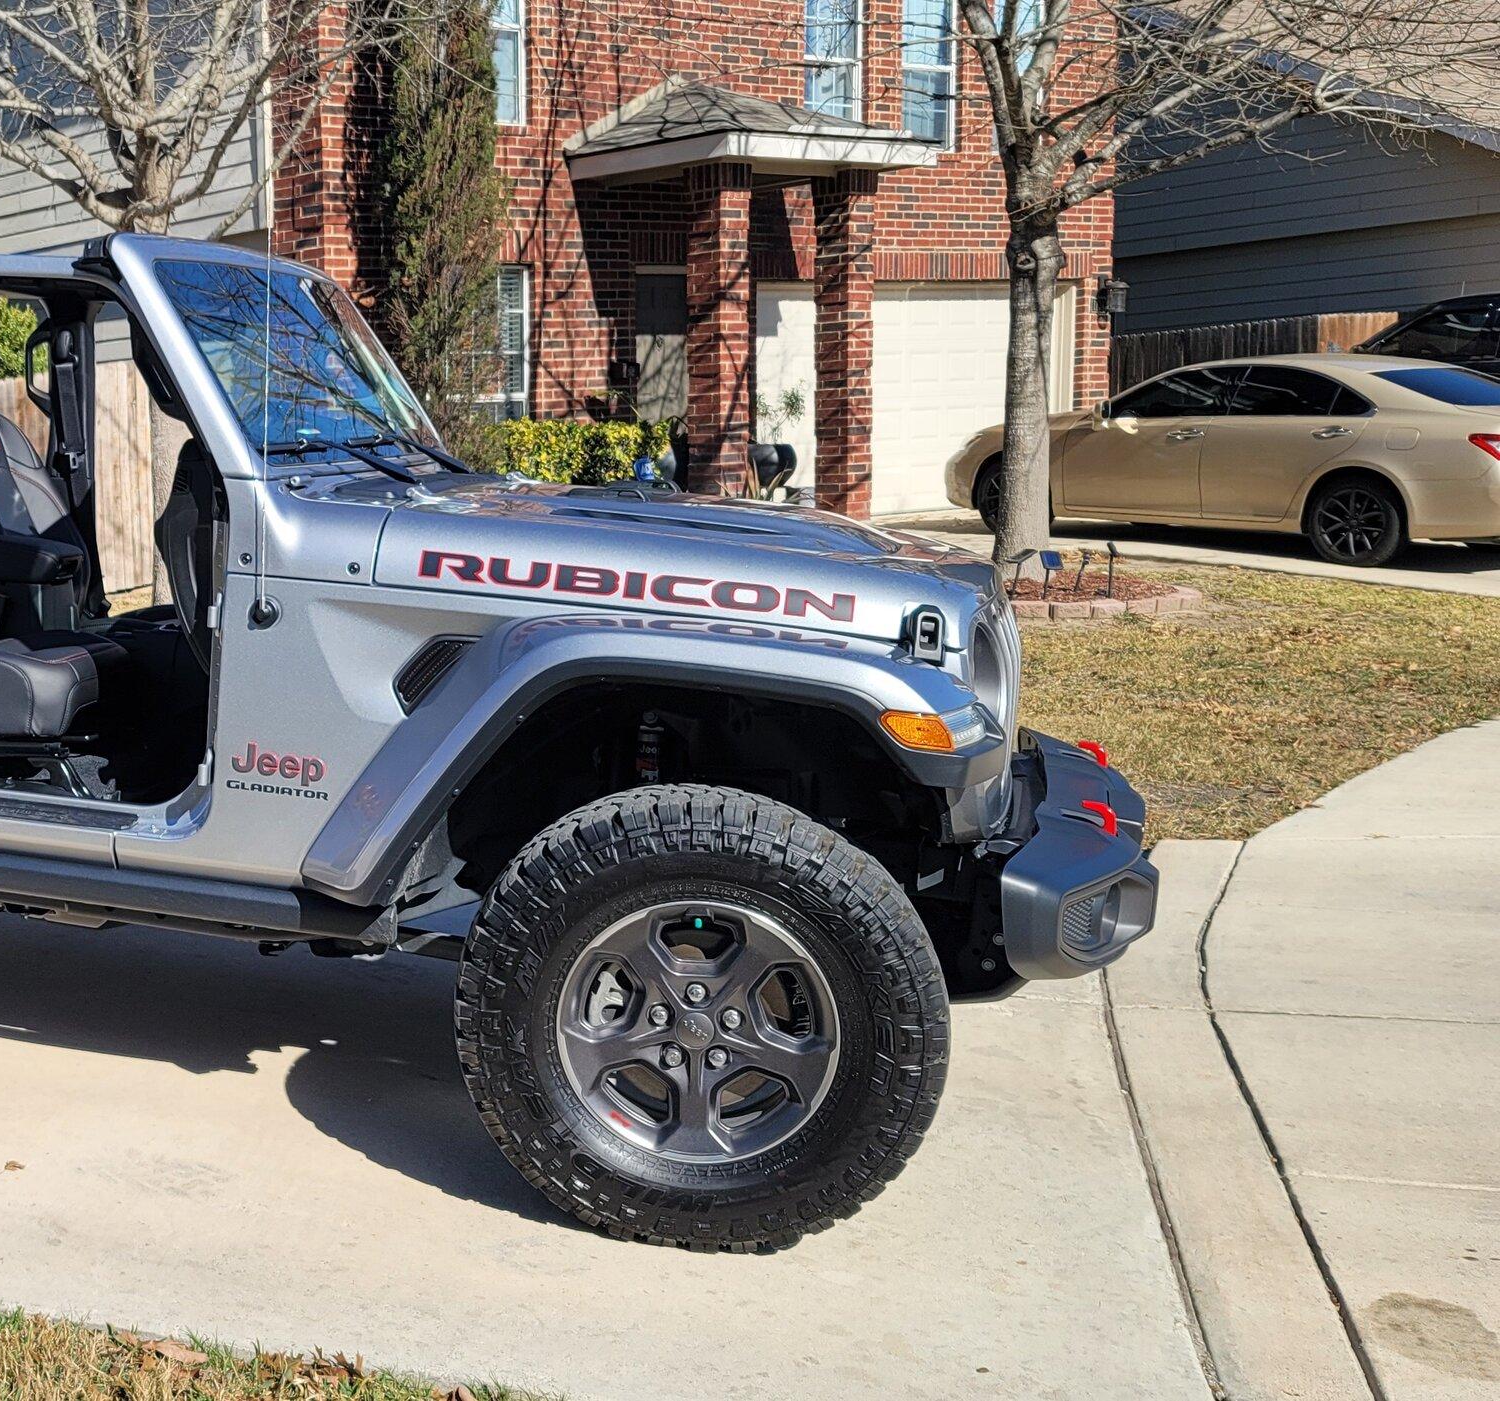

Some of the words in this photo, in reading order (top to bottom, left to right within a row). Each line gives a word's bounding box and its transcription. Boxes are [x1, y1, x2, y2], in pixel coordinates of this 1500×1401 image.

[417, 549, 856, 623] RUBICON
[226, 779, 329, 801] GLADIATOR
[231, 740, 328, 787] Jeep
[514, 902, 567, 999] M/T
[777, 880, 896, 1097] FALKEN
[682, 1019, 708, 1042] Jeep
